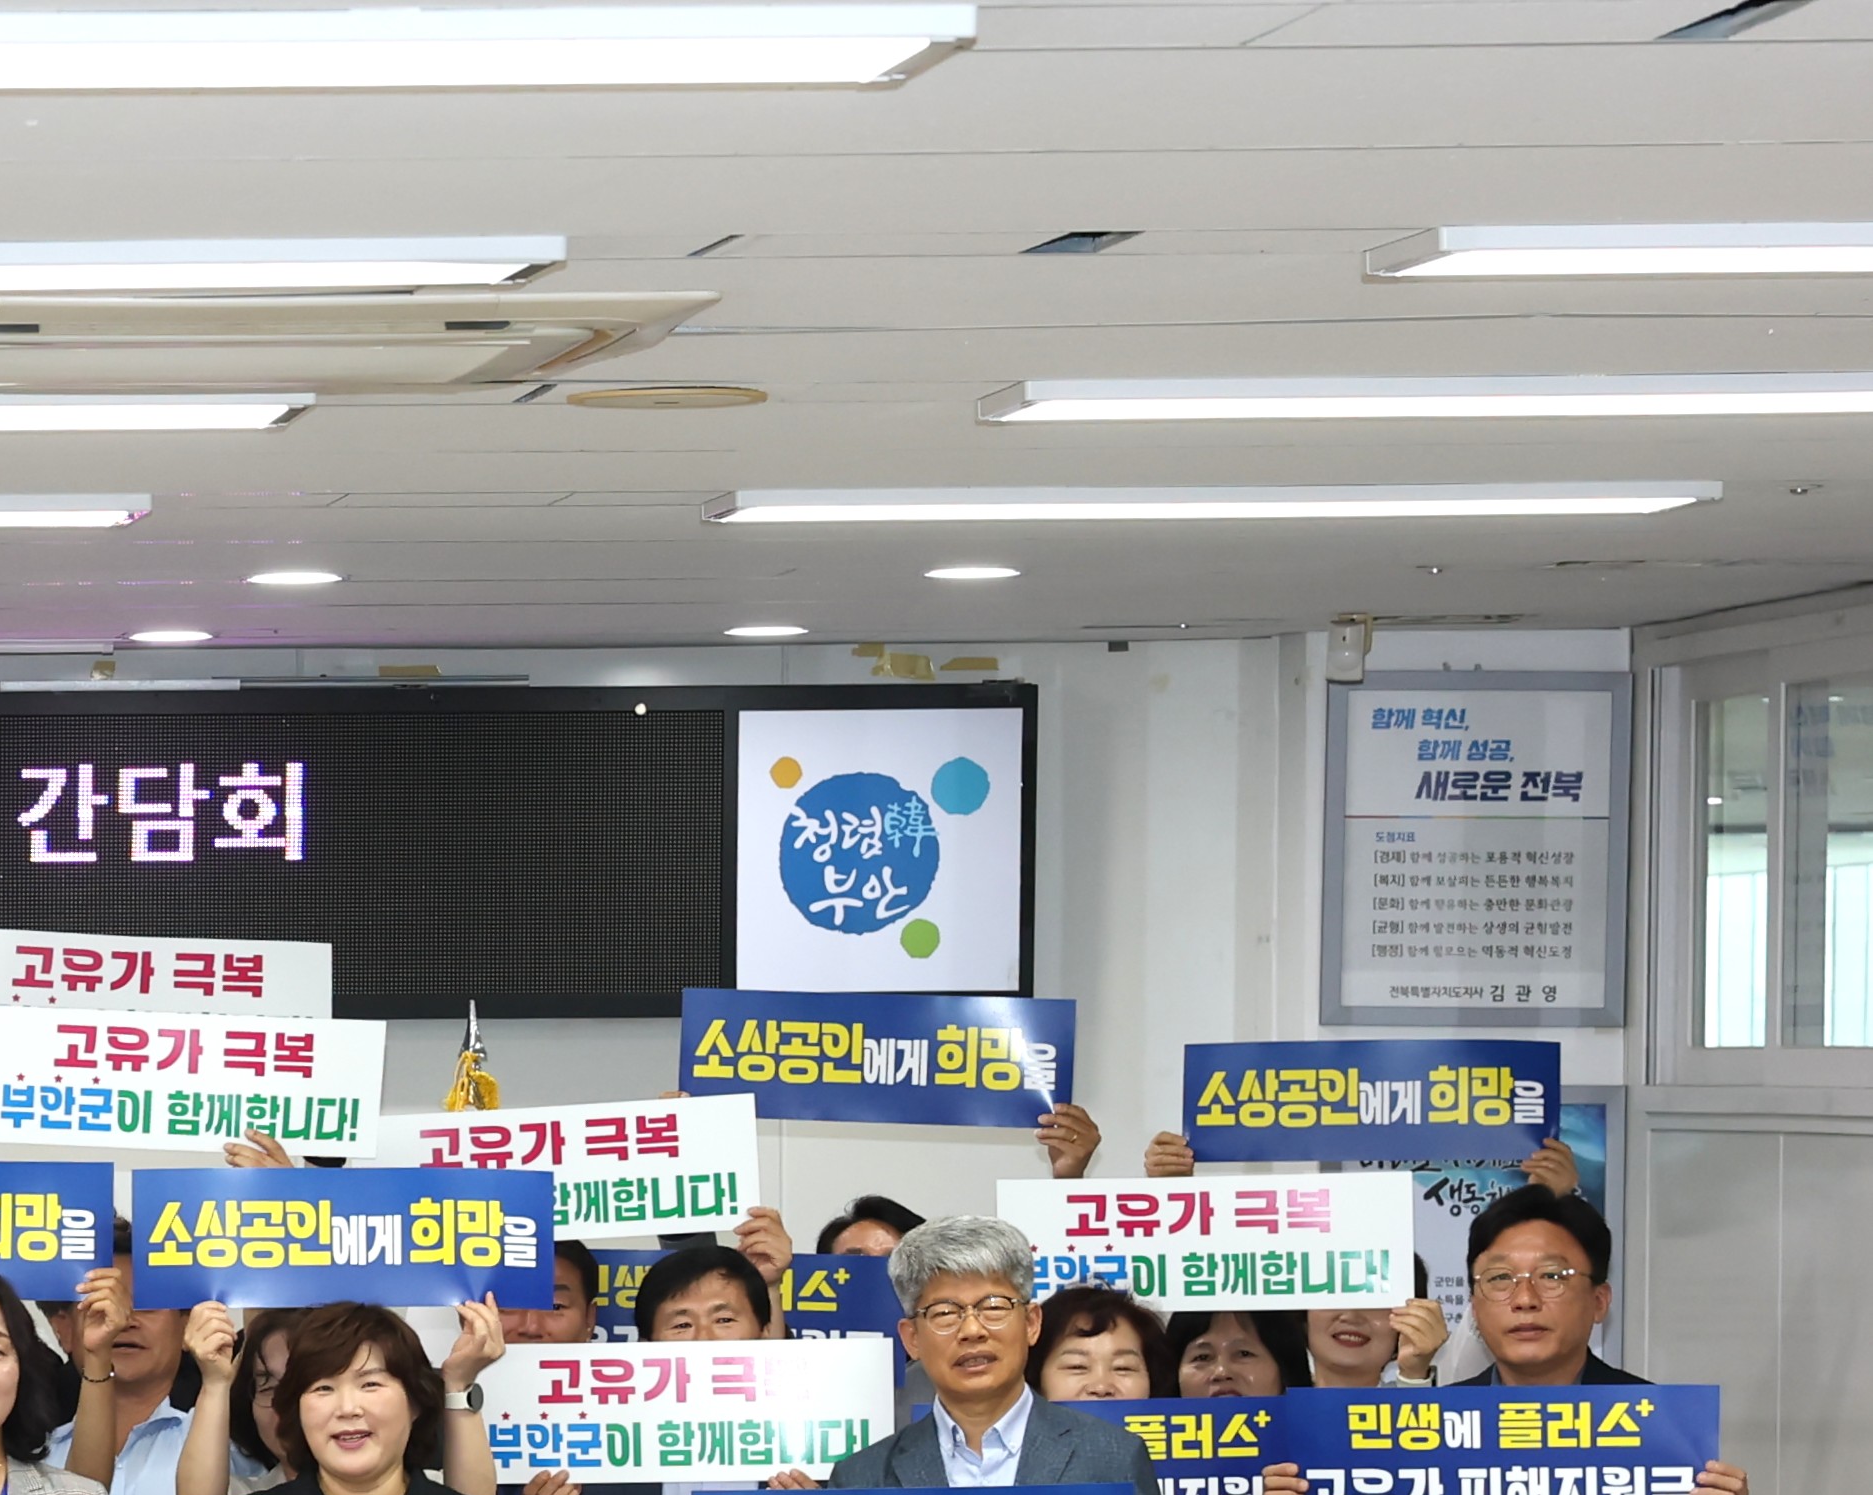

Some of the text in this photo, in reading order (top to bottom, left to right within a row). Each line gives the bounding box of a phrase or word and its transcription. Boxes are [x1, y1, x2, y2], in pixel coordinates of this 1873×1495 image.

[1371, 708, 1470, 732] 함께 혁신,
[1417, 740, 1515, 762] 함께 성공,
[16, 763, 304, 862] 간담회
[1415, 771, 1584, 802] 새로운 전북
[809, 865, 911, 926] 부안
[13, 946, 263, 997] 고유가 극복
[55, 1025, 313, 1078] 고유가 극복
[693, 1020, 1055, 1091] 소상공인에게 희망을
[1, 1085, 359, 1142] 부안군이 함께합니다!
[1197, 1066, 1543, 1127] 소상공인에게 희망을
[418, 1114, 678, 1168] 고유가 극복
[555, 1172, 737, 1226] 함께합니다!
[1067, 1191, 1332, 1237] 고유가 극복
[149, 1198, 536, 1268] 소상공인에게 희망을
[1183, 1251, 1389, 1296] 함께합니다!
[539, 1359, 689, 1404] 고유가
[490, 1423, 642, 1468] 부안군이
[1348, 1404, 1480, 1450] 민생에
